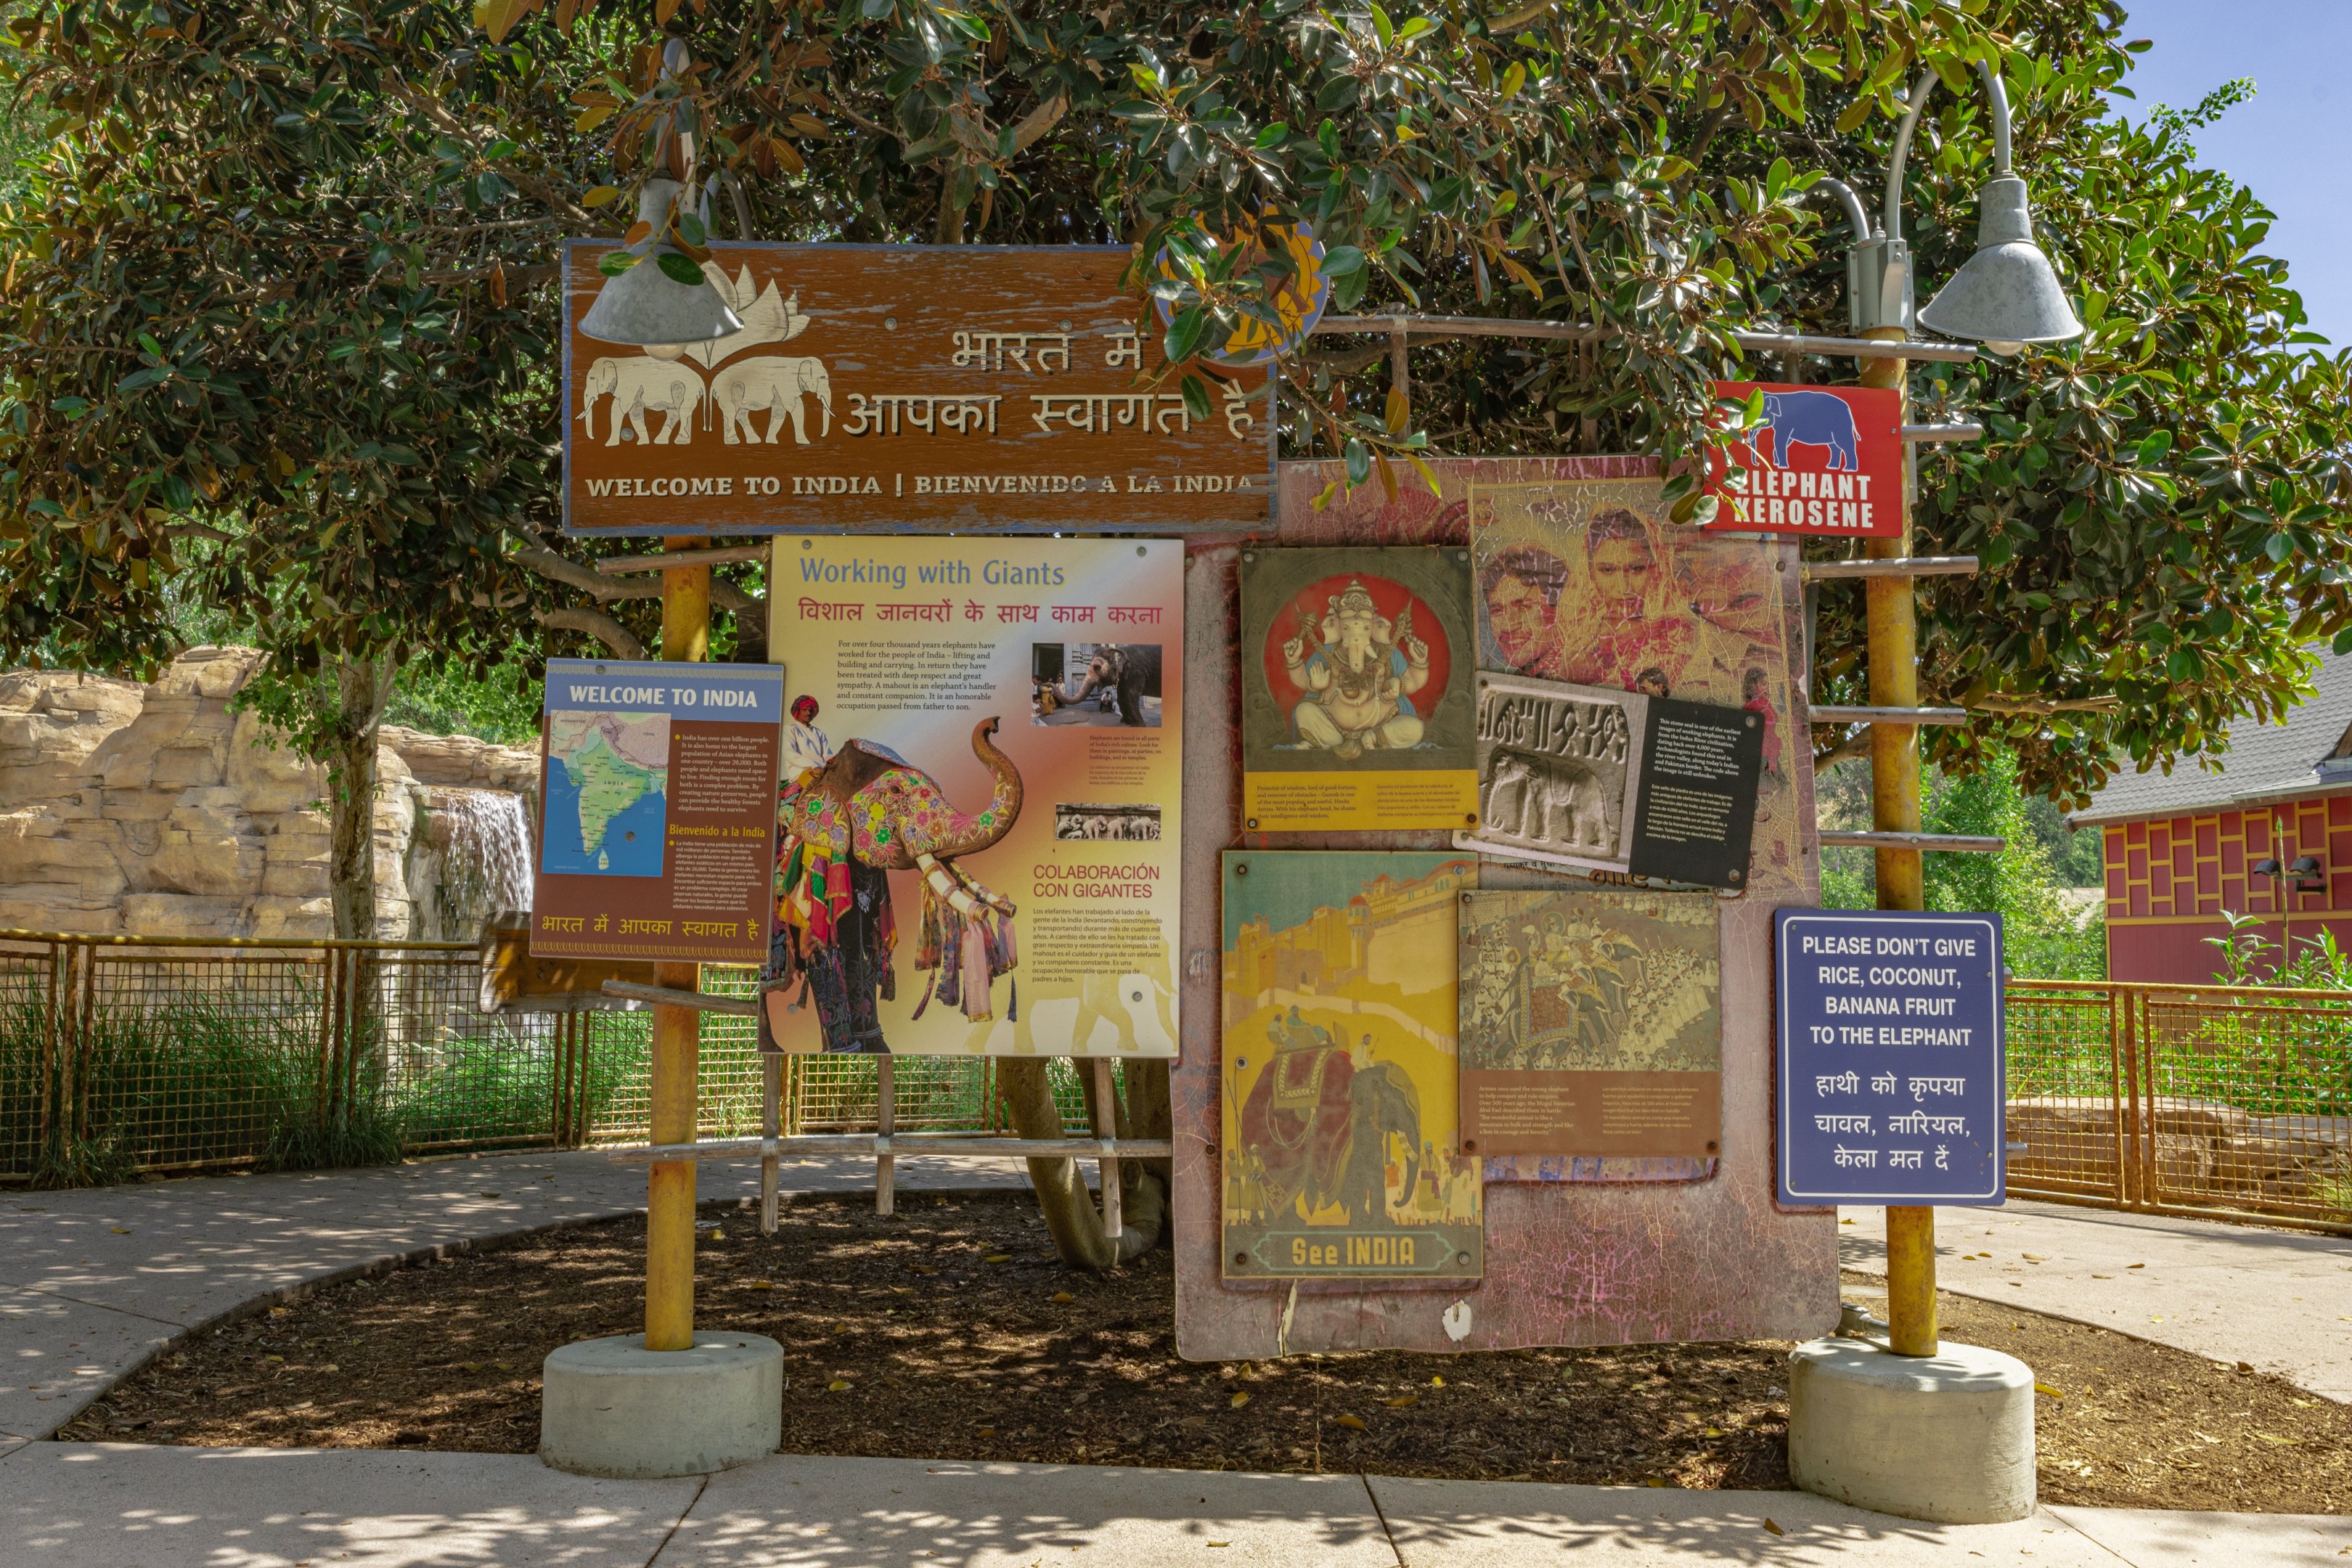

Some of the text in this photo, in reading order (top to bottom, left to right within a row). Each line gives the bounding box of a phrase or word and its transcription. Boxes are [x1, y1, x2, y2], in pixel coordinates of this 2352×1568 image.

[952, 331, 1074, 372] भारत
[842, 379, 1254, 441] आपका स्वागत है
[585, 477, 732, 497] WELCOME
[744, 476, 781, 495] TO
[793, 476, 883, 495] INDIA
[915, 475, 1087, 494] BIENVENIDO
[1098, 475, 1117, 494] A
[1127, 475, 1163, 494] LA
[1173, 475, 1253, 494] INDIA
[1734, 497, 1874, 528] KEROSENE
[800, 558, 1064, 589] Working with Giants
[799, 597, 1163, 624] विशाल जानवरों के साथ काम करना
[891, 650, 915, 660] people
[952, 651, 975, 661] lifting
[942, 640, 977, 650] elephants
[837, 660, 867, 670] building
[883, 661, 915, 670] carrying.
[952, 661, 968, 671] they
[902, 671, 918, 680] deep
[836, 681, 873, 690] sympathy.
[570, 686, 757, 707] WELCOME TO INDIA
[836, 702, 875, 711] occupation
[877, 702, 902, 711] passed
[669, 824, 719, 836] Bienvenido
[731, 827, 739, 836] la
[743, 827, 765, 837] India
[1034, 863, 1159, 880] COLABORACIÓN
[1034, 883, 1152, 898] CON GIGANTES
[542, 914, 759, 941] भारत में आपका स्वागत है
[1803, 936, 1975, 956] PLEASE DON'T GIVE
[1819, 967, 1961, 989] RICE, COCONUT,
[1826, 997, 1956, 1016] BANANA FRUIT
[1810, 1026, 1972, 1045] TO THE ELEPHANT
[1816, 1071, 1965, 1102] हाथी को कृपया
[1814, 1110, 1969, 1137] चावल, नारियल,
[1834, 1144, 1949, 1170] केला मत दें
[1293, 1237, 1414, 1265] See INDIA
